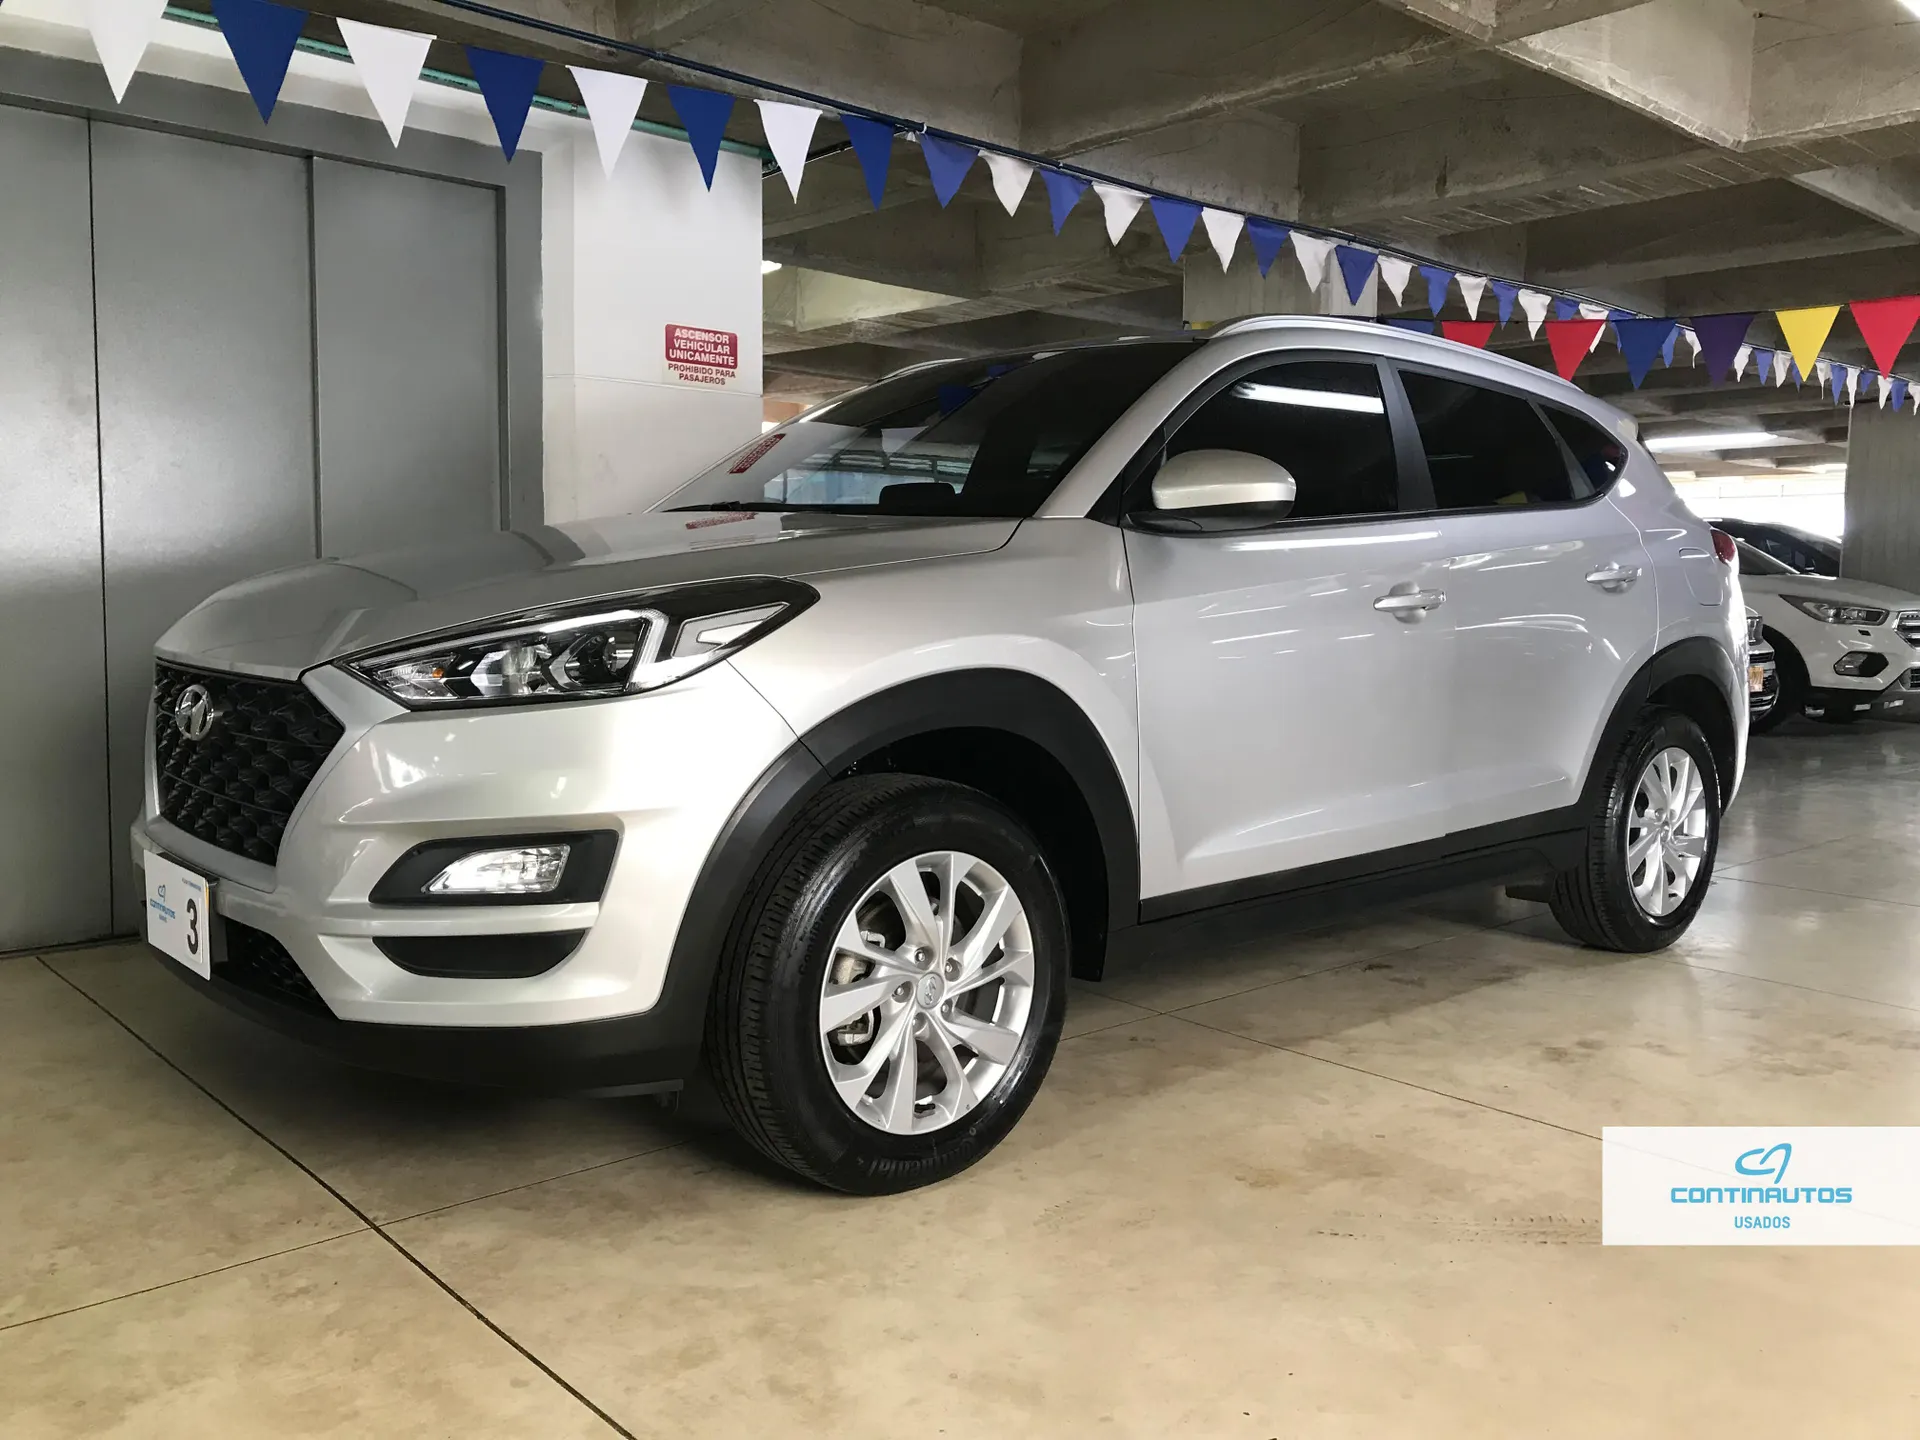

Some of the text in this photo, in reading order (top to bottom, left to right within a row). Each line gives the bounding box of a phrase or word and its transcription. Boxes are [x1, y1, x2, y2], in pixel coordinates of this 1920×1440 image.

[674, 328, 729, 344] ASCENSOR
[673, 339, 730, 354] VEHICULAR
[669, 349, 735, 366] UNICAMENTE
[668, 363, 736, 378] PROHIBIDO PARA
[679, 373, 725, 385] PASAJEROS
[187, 898, 199, 955] 3
